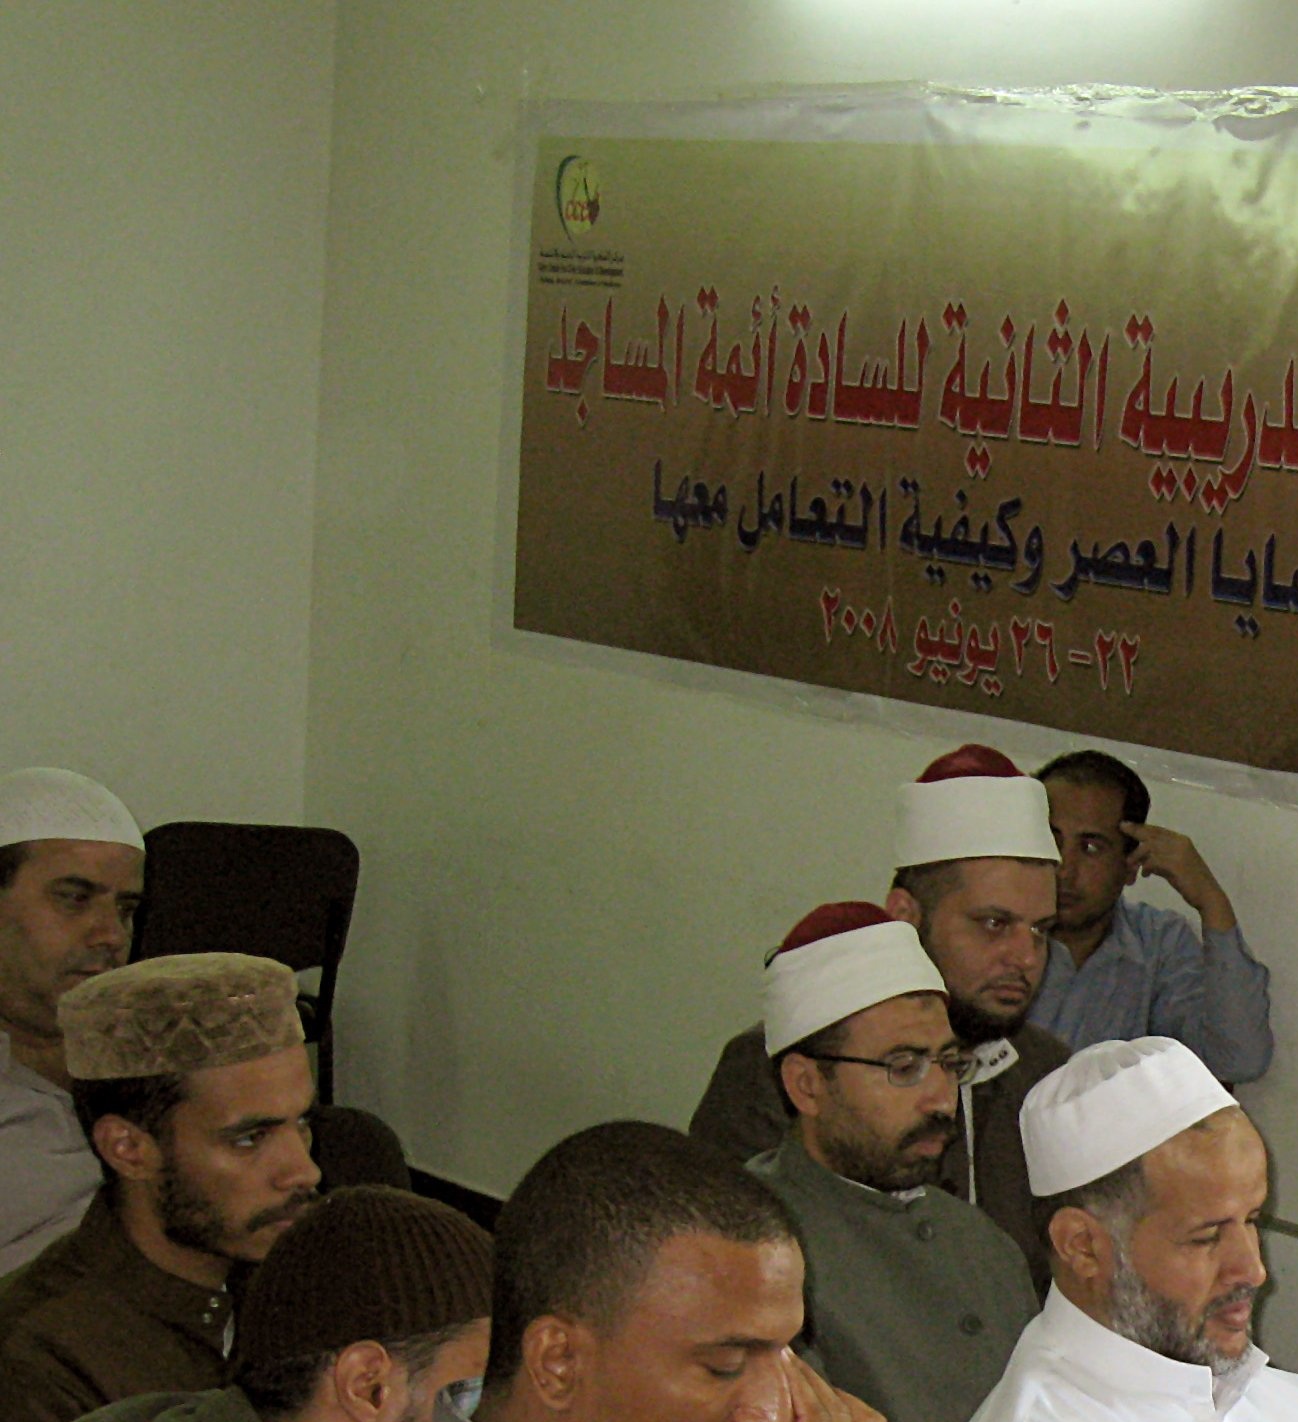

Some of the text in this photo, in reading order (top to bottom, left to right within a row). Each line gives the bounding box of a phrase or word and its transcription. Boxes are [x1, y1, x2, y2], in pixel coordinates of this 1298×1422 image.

[545, 293, 686, 427] المساجد
[694, 284, 780, 418] أئمة
[784, 302, 930, 428] للسادة
[937, 298, 1110, 478] الثانية
[652, 458, 729, 544] معها
[737, 470, 888, 554] التعامل
[898, 477, 1046, 594] وكيفية
[1050, 520, 1198, 602] العصر
[819, 585, 897, 656] ٢٠٠٨
[907, 599, 1003, 697] يونيو
